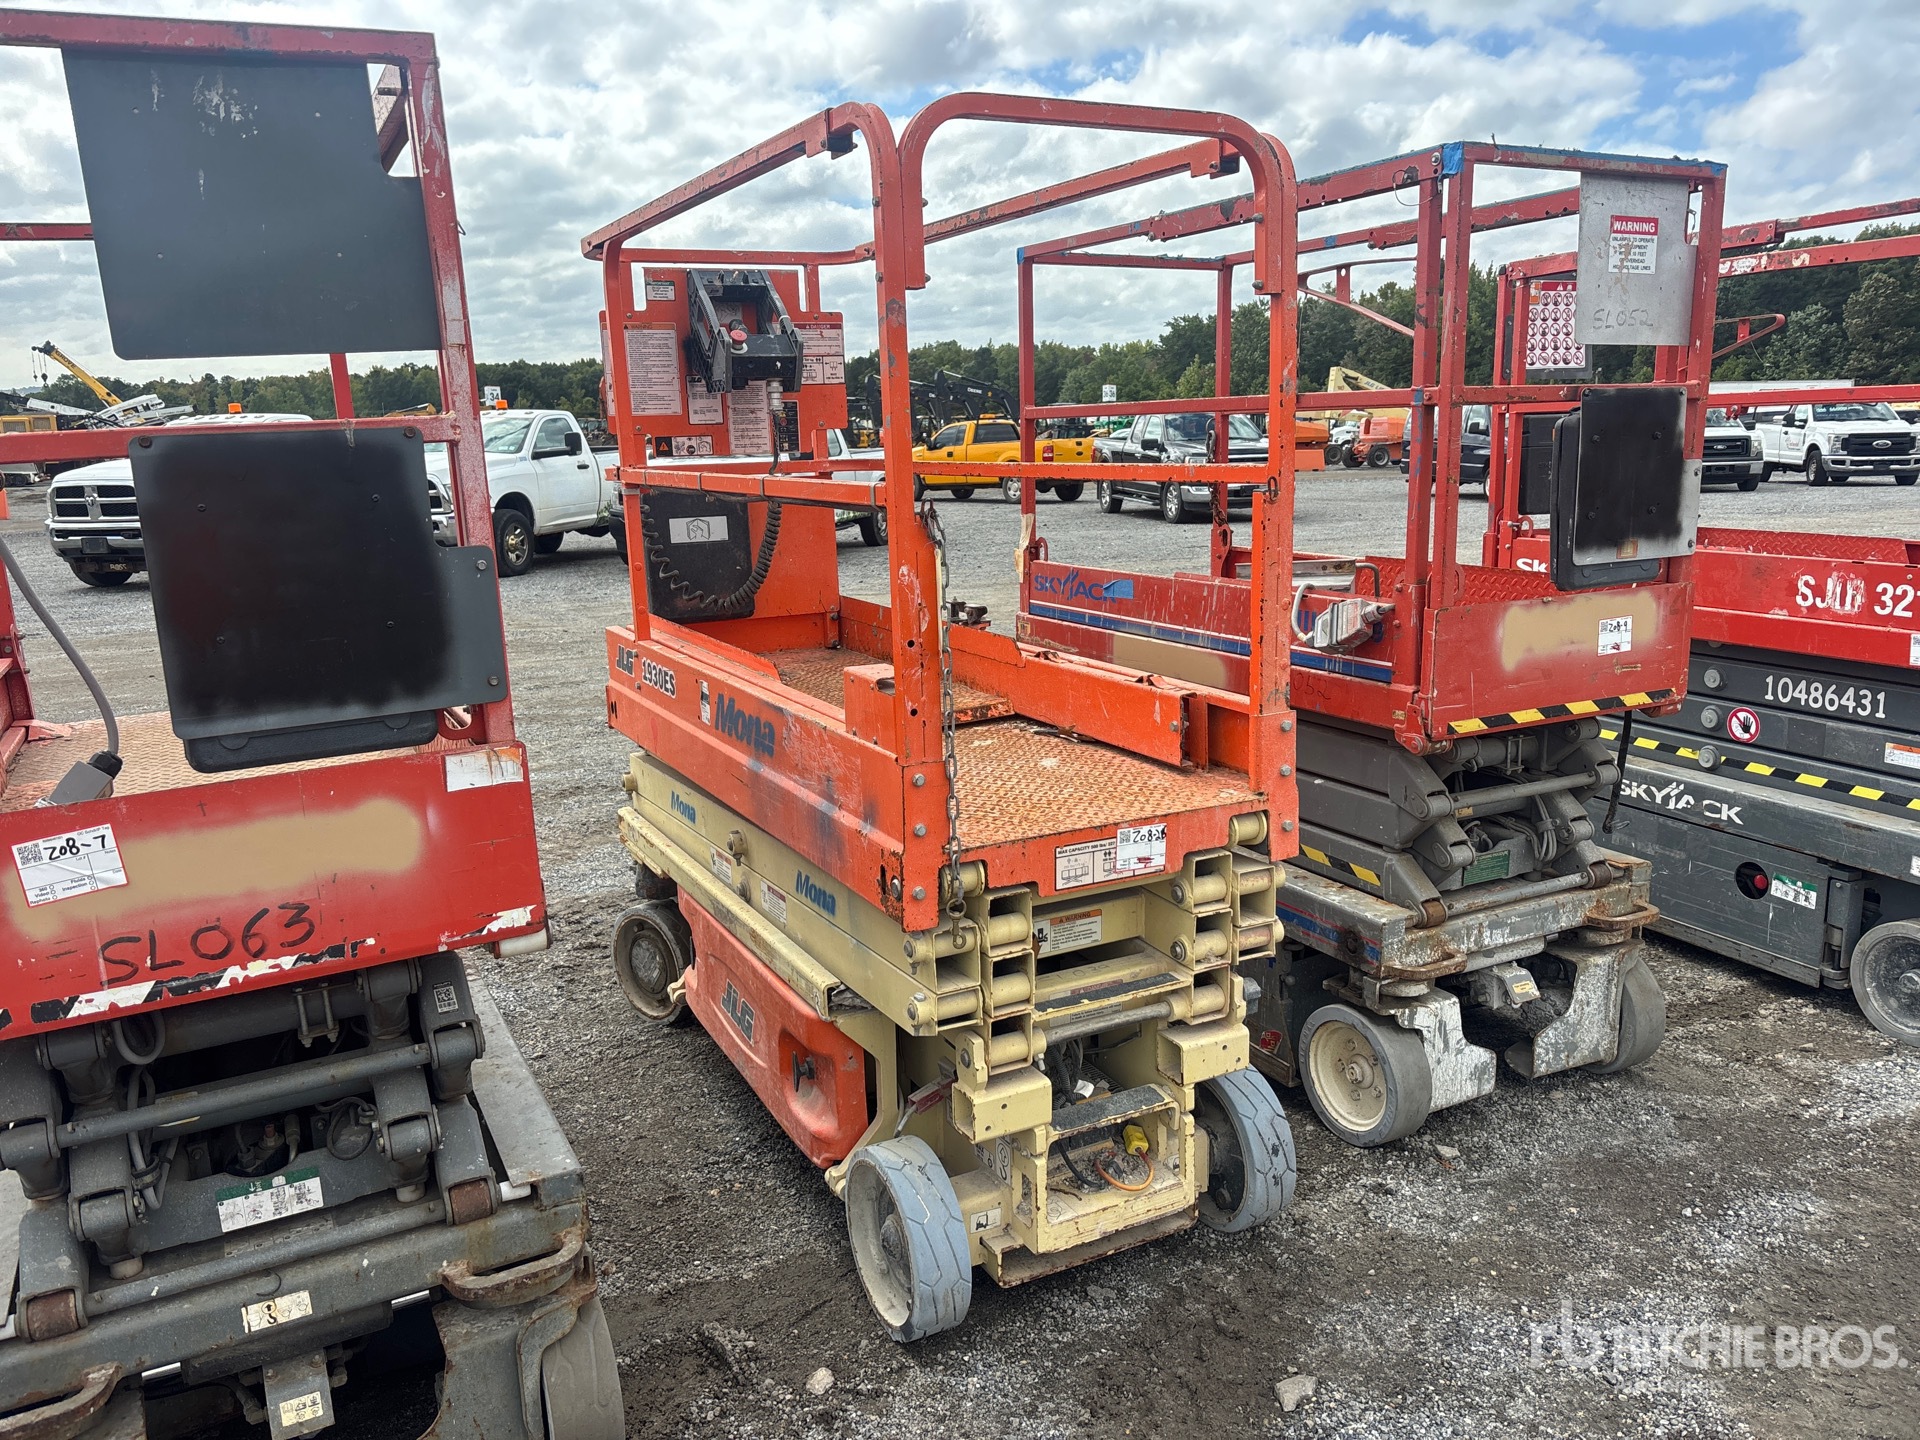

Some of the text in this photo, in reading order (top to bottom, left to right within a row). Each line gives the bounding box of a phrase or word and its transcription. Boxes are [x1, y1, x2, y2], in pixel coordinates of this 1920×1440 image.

[1614, 221, 1655, 232] WARNING
[490, 392, 500, 402] 34
[1034, 569, 1116, 604] SKYJAC
[1873, 582, 1920, 618] 32
[616, 644, 634, 678] JLG
[642, 657, 676, 699] 1930ES
[1764, 675, 1886, 718] 10486431
[714, 693, 776, 758] Mona
[671, 790, 696, 824] Mona
[1069, 845, 1090, 854] CAPACITY
[796, 870, 836, 917] Mona
[1065, 912, 1090, 922] WARNING
[720, 978, 755, 1047] JLG
